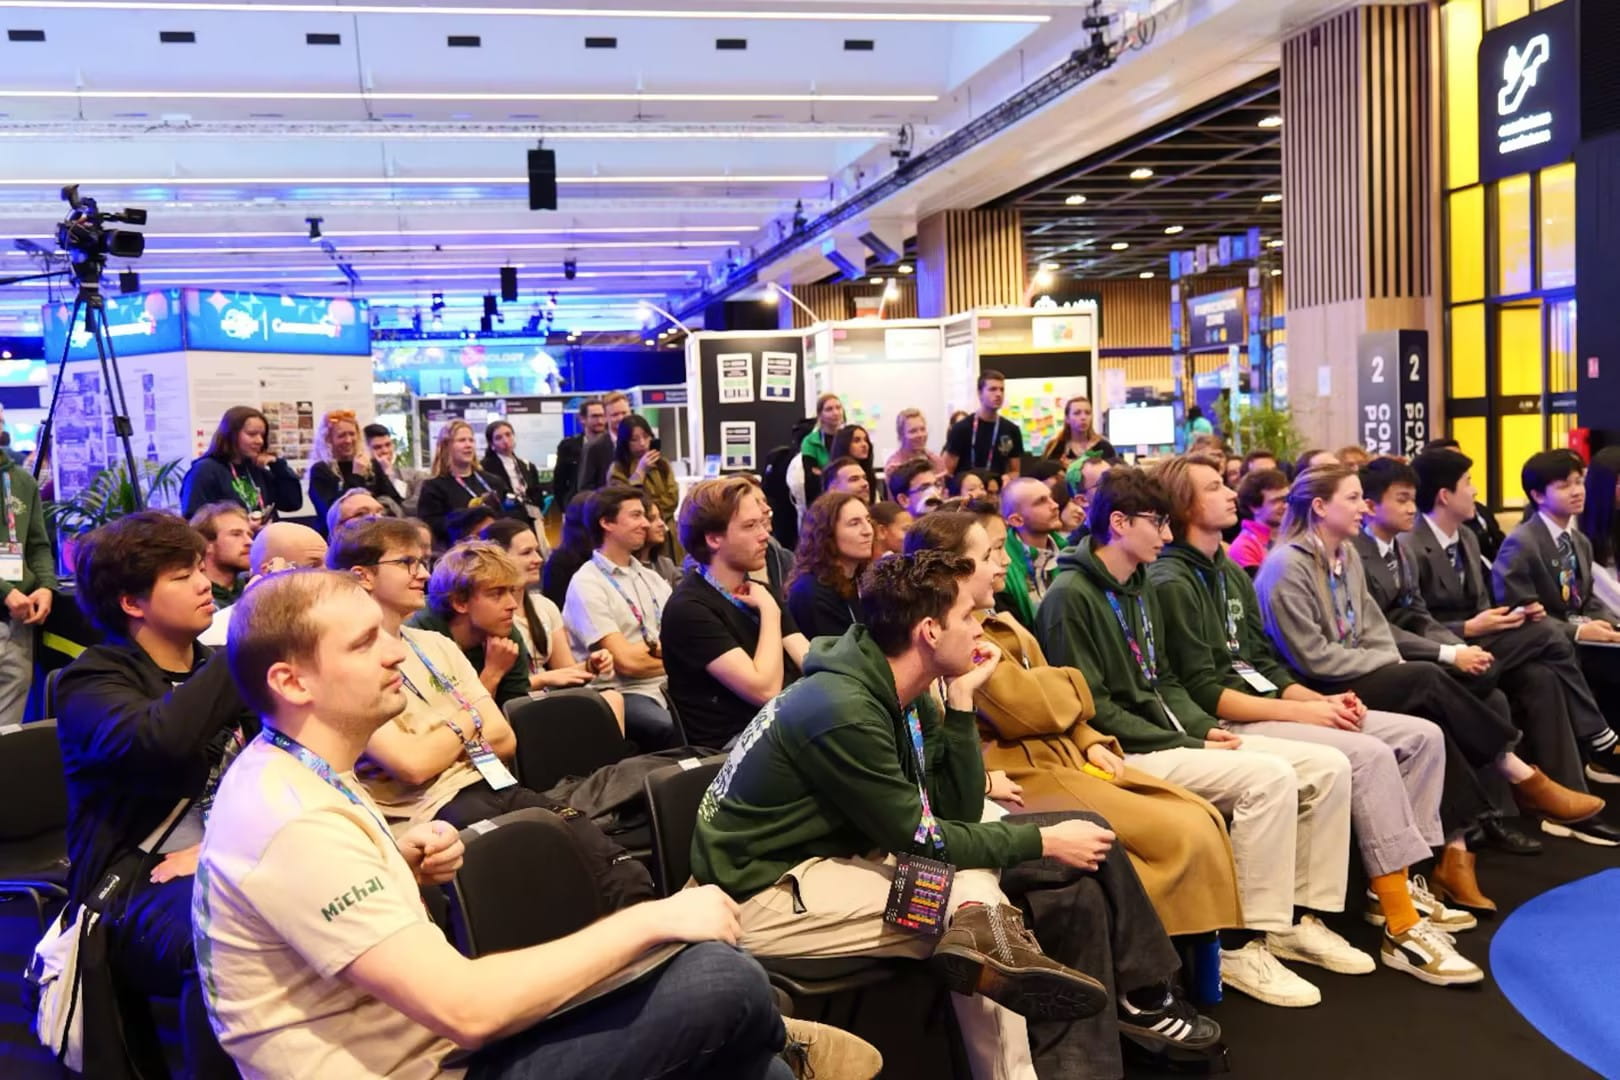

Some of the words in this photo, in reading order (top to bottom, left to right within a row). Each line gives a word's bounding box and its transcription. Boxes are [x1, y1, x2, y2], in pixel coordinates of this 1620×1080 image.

[1371, 355, 1384, 383] 2
[1409, 354, 1420, 381] 2
[321, 875, 384, 922] Michal
